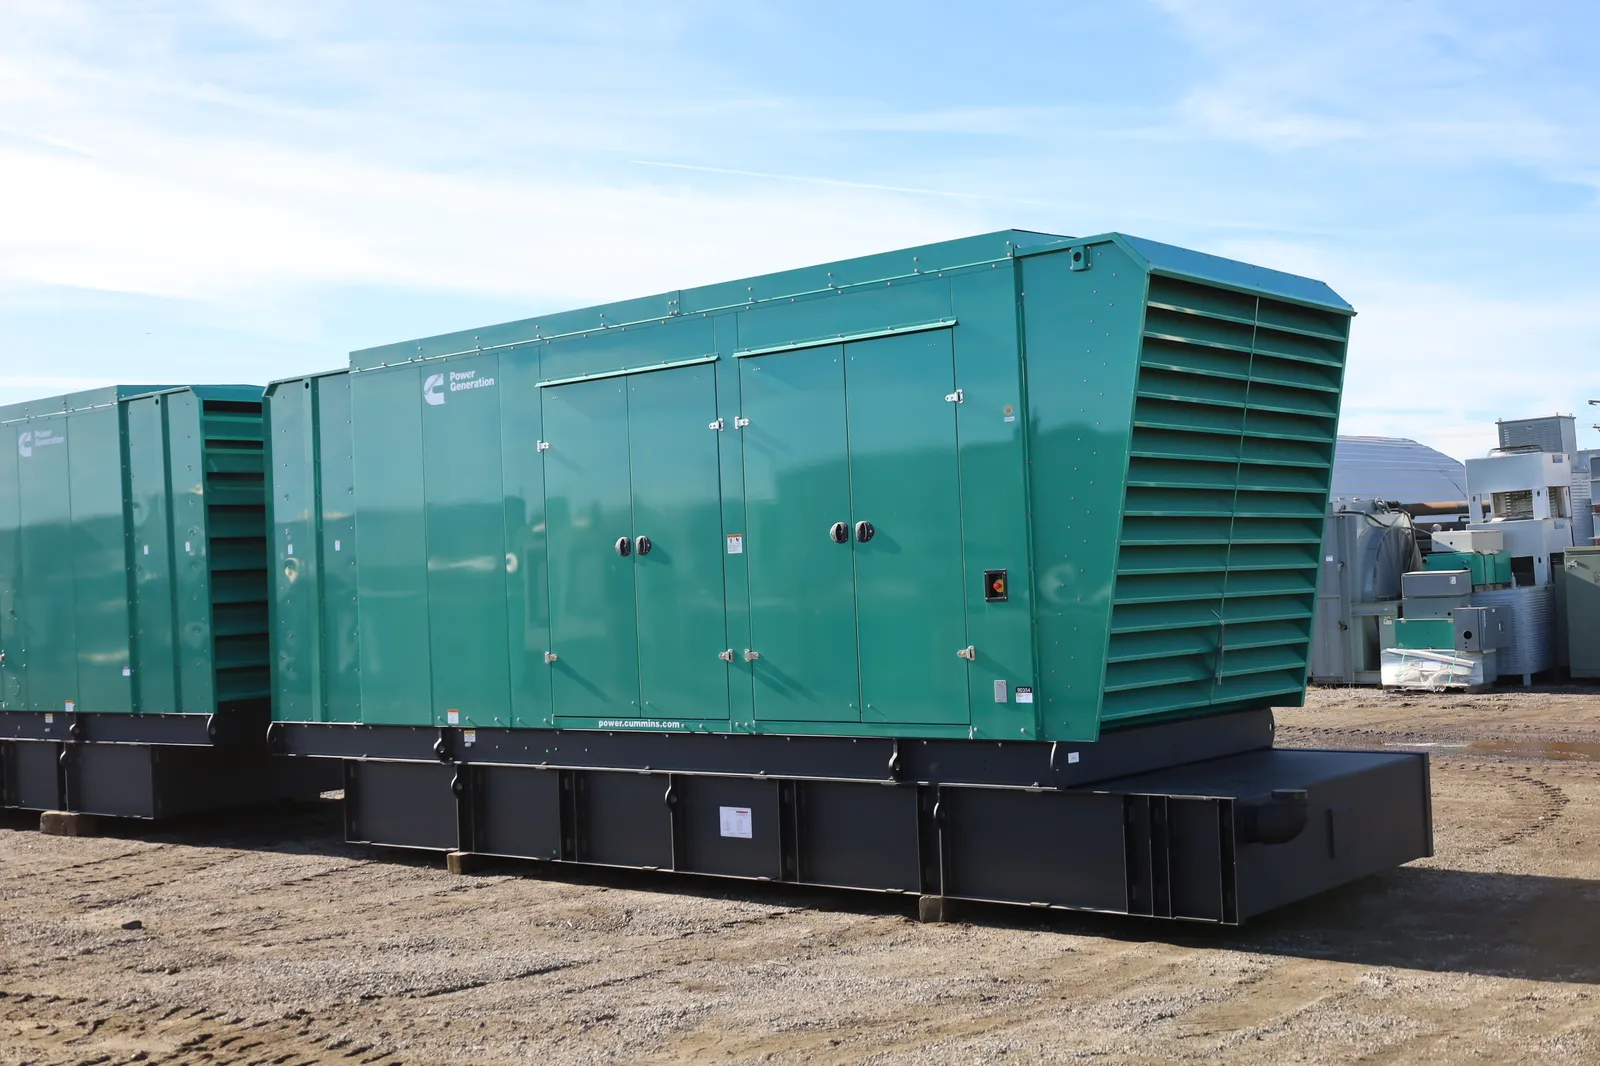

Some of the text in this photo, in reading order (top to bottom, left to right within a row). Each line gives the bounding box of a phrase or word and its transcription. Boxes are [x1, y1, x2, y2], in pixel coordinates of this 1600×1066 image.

[450, 371, 475, 381] Power
[450, 377, 495, 391] Generation
[598, 719, 680, 728] power.cummins.com
